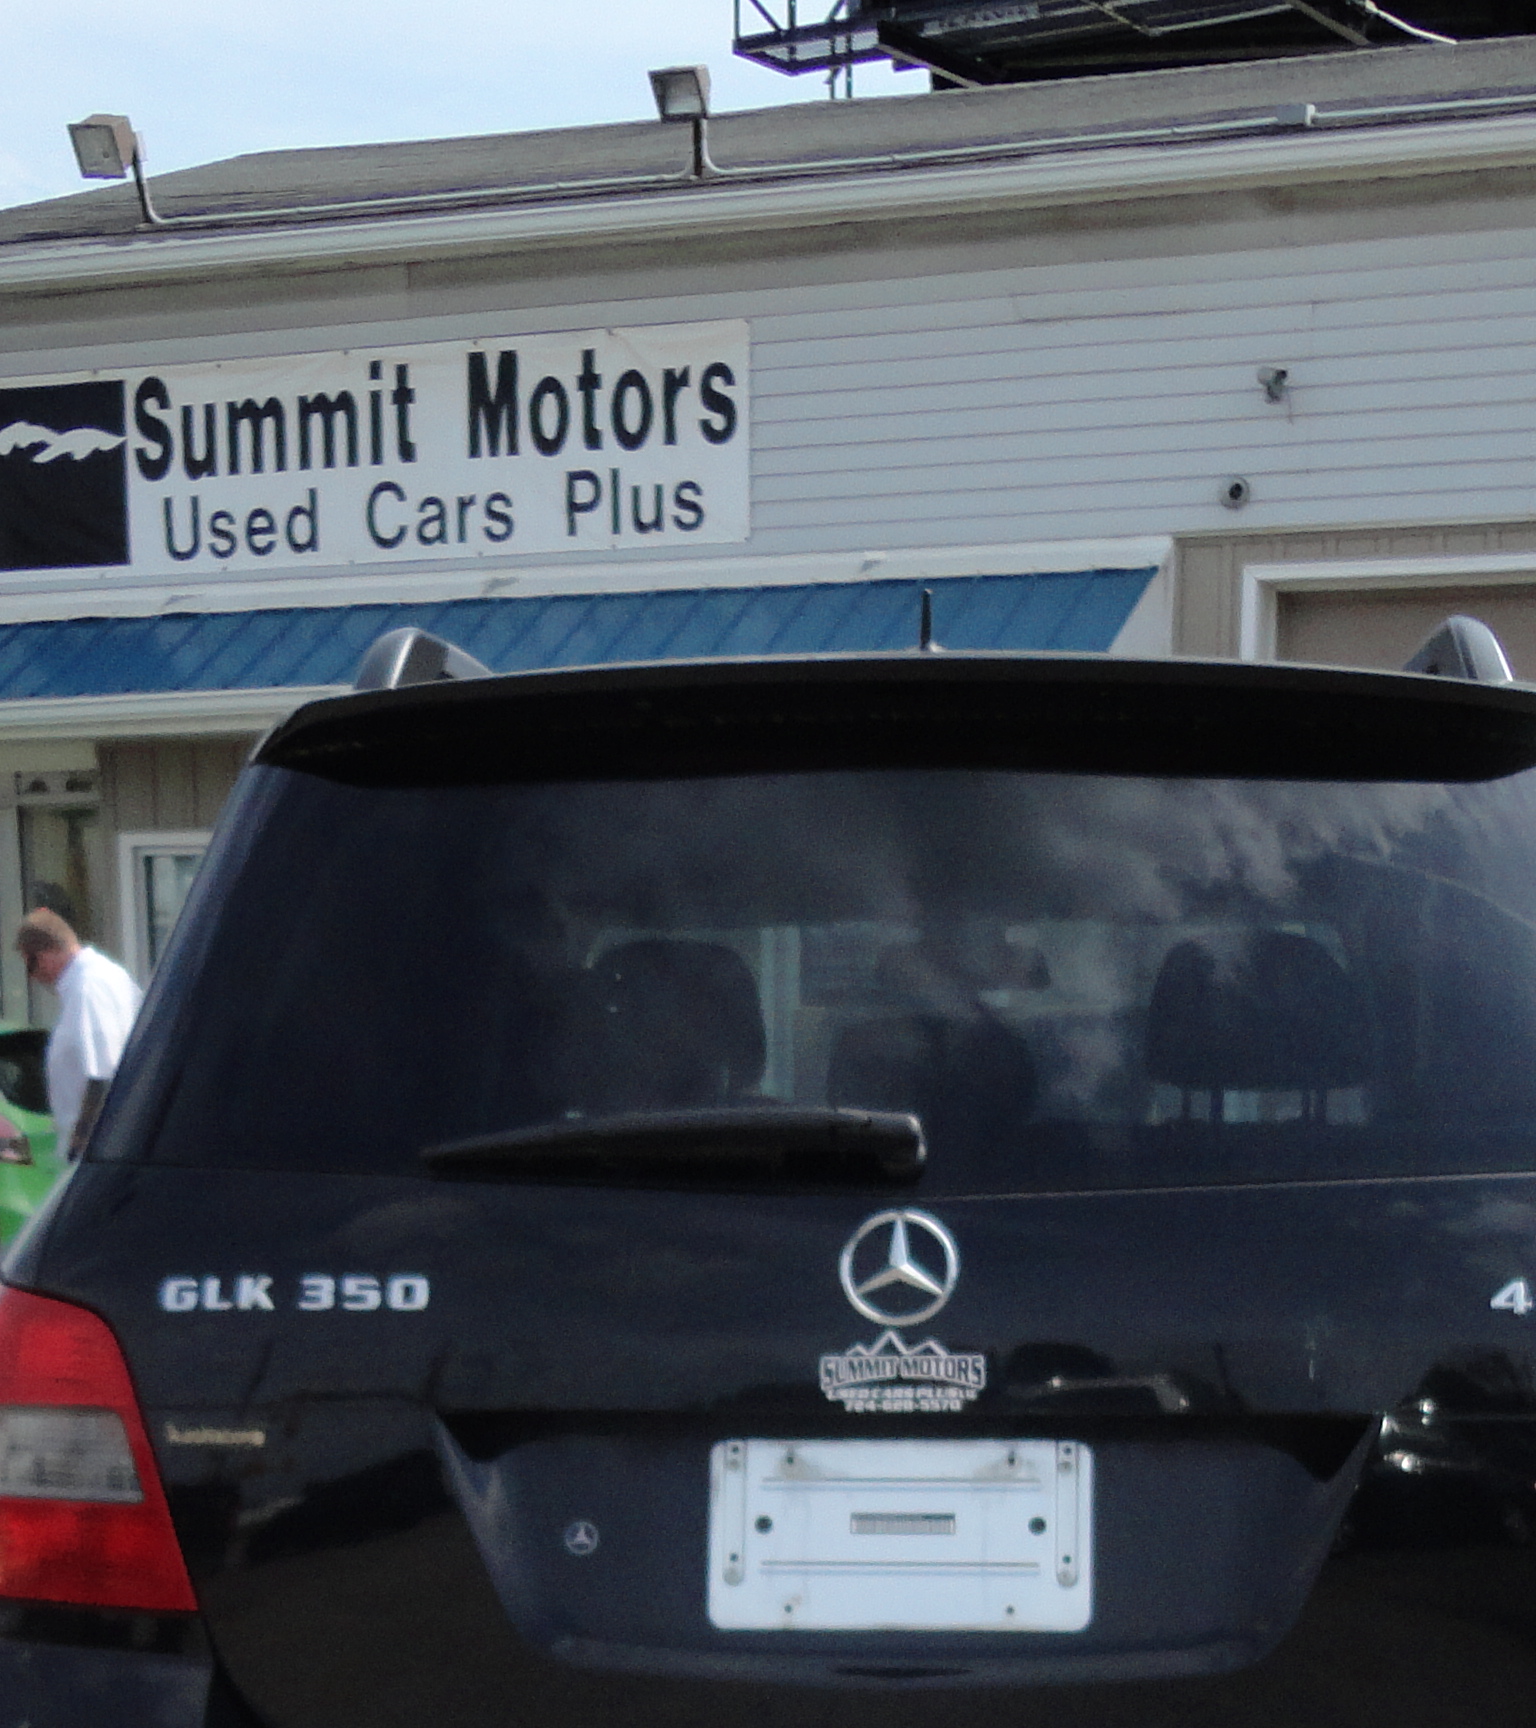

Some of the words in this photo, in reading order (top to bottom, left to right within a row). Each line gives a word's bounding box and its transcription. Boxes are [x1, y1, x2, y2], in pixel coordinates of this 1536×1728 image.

[133, 359, 417, 482] Summit
[467, 348, 738, 460] Motors
[163, 488, 321, 562] Used
[365, 481, 515, 550] Cars
[566, 467, 706, 537] Plus
[161, 1273, 276, 1312] GLK
[297, 1272, 431, 1312] 350
[822, 1356, 898, 1387] SUMMIT
[900, 1356, 985, 1388] MOTORS
